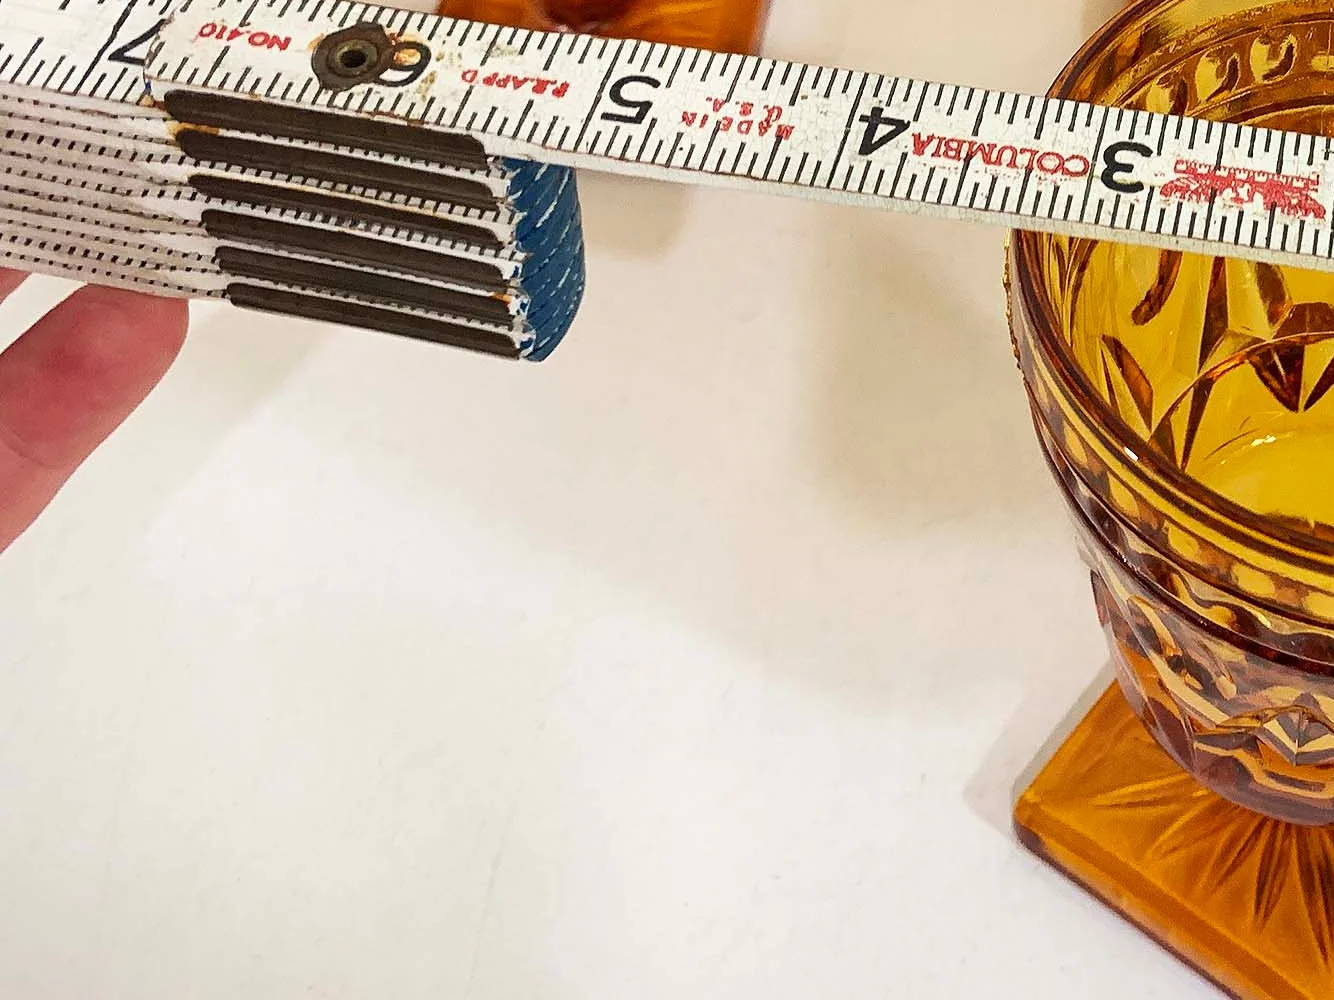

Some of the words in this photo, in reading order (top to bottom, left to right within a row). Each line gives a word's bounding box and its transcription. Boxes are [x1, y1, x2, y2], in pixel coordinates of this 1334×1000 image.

[108, 17, 167, 67] 7
[600, 75, 662, 126] 5
[681, 110, 710, 128] IN
[717, 115, 795, 141] MADE
[858, 106, 911, 156] 4
[911, 131, 1090, 178] COLUMBIA
[1101, 141, 1154, 194] 3
